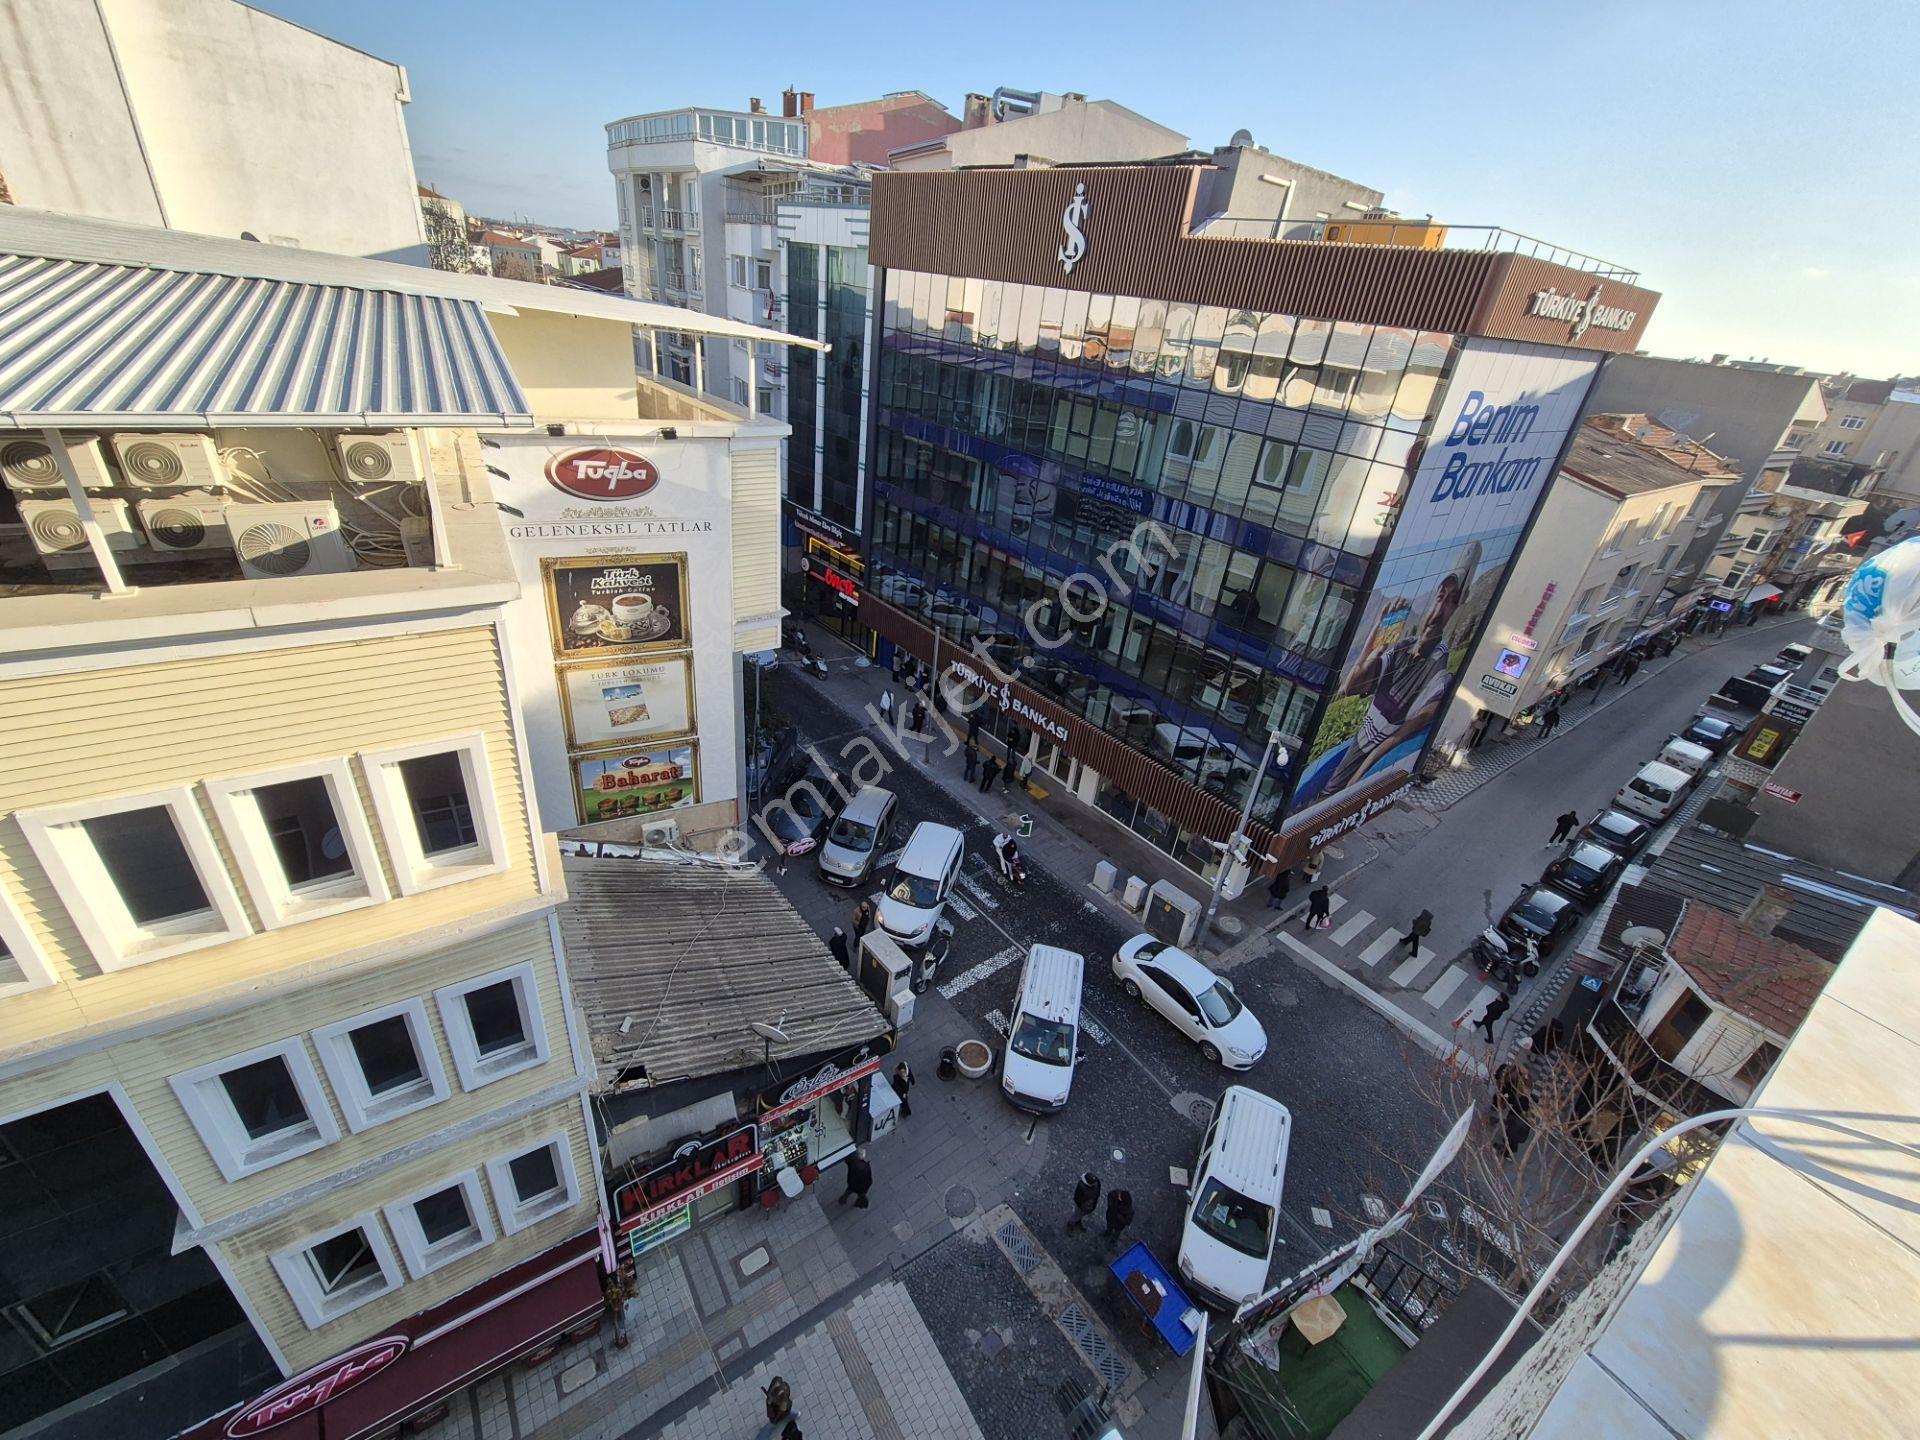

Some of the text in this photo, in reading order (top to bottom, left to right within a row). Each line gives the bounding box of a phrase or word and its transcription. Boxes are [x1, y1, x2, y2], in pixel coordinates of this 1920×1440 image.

[1533, 287, 1587, 323] TÜRKİYE
[1445, 390, 1539, 447] Benim
[1430, 447, 1542, 503] Bankam
[510, 521, 713, 539] GELENEKSEL TATLAR
[591, 575, 652, 589] Kahvesi
[604, 568, 639, 580] Türk
[950, 659, 1068, 742] TÜRKİYE BANKASI
[602, 766, 679, 790] Baharat
